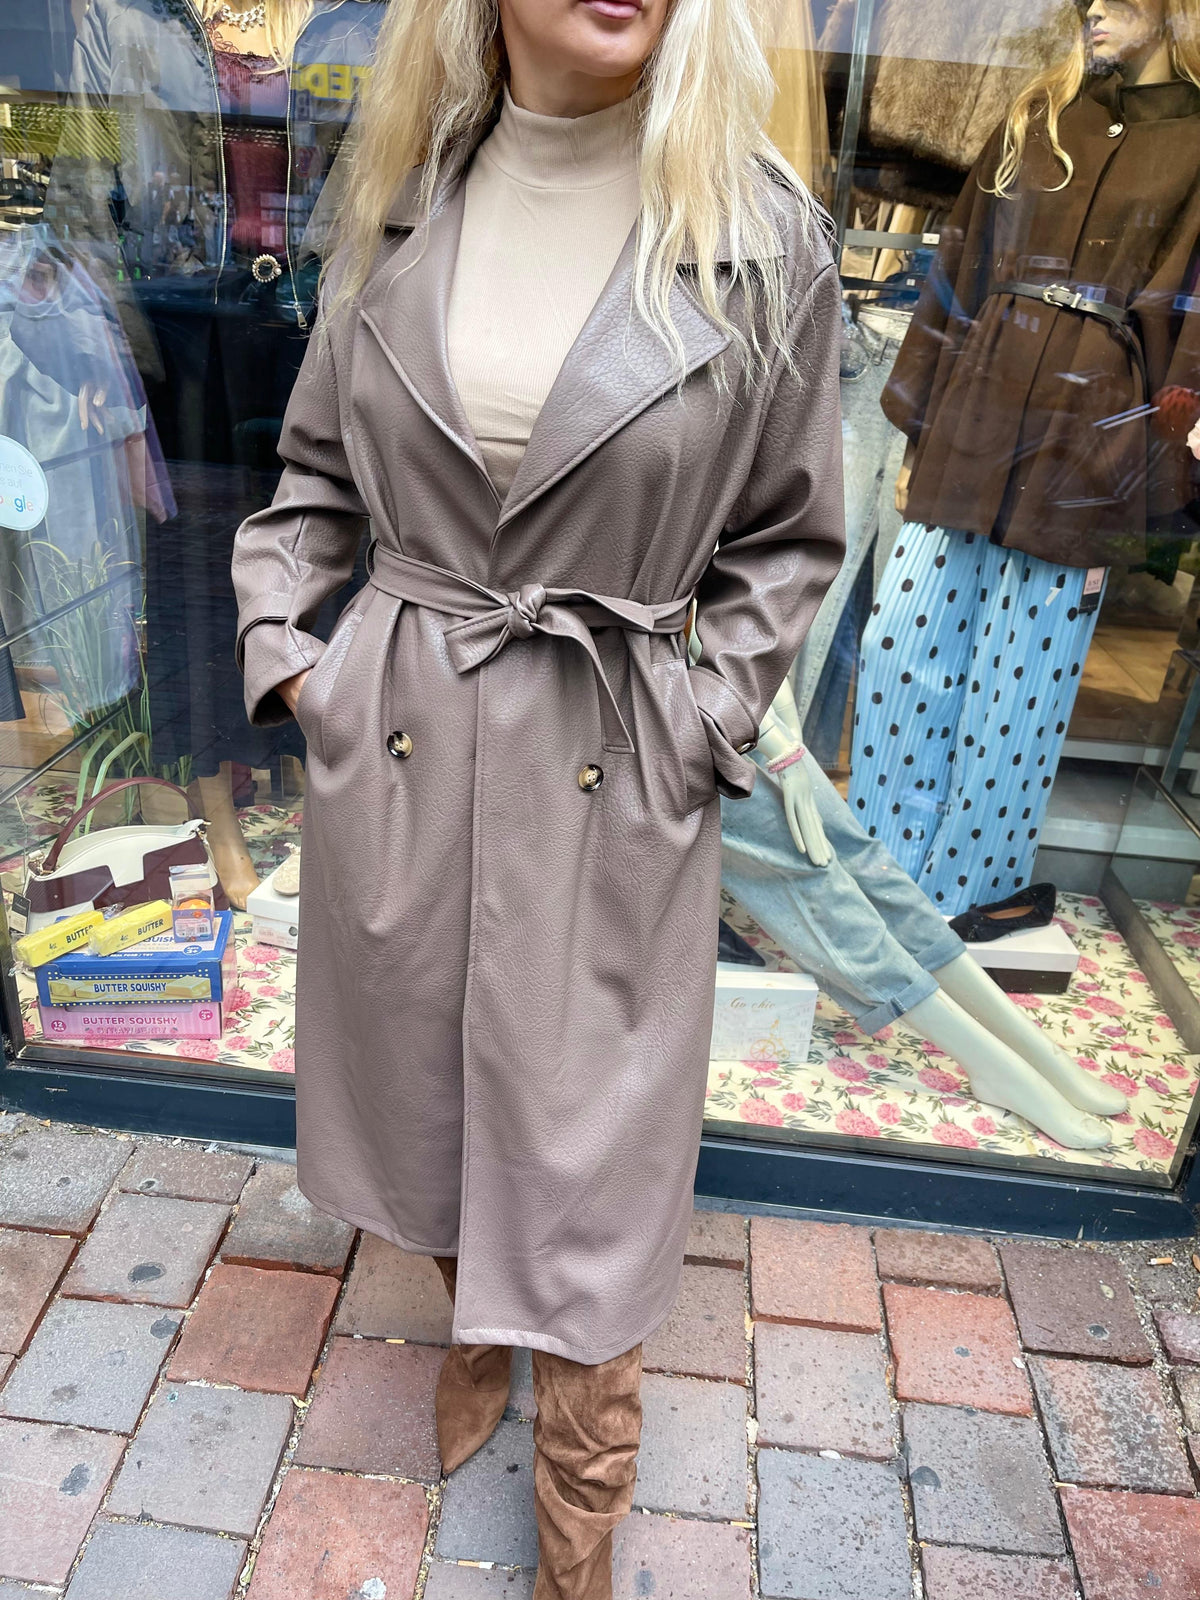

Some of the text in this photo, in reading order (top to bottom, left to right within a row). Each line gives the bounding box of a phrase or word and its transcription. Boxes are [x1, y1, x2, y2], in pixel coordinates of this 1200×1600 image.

[137, 918, 164, 936] BUTTER
[94, 983, 167, 993] BUTTER SQUISHY
[730, 996, 776, 1009] Go chic
[83, 1017, 178, 1025] BUTTER SQUISHY
